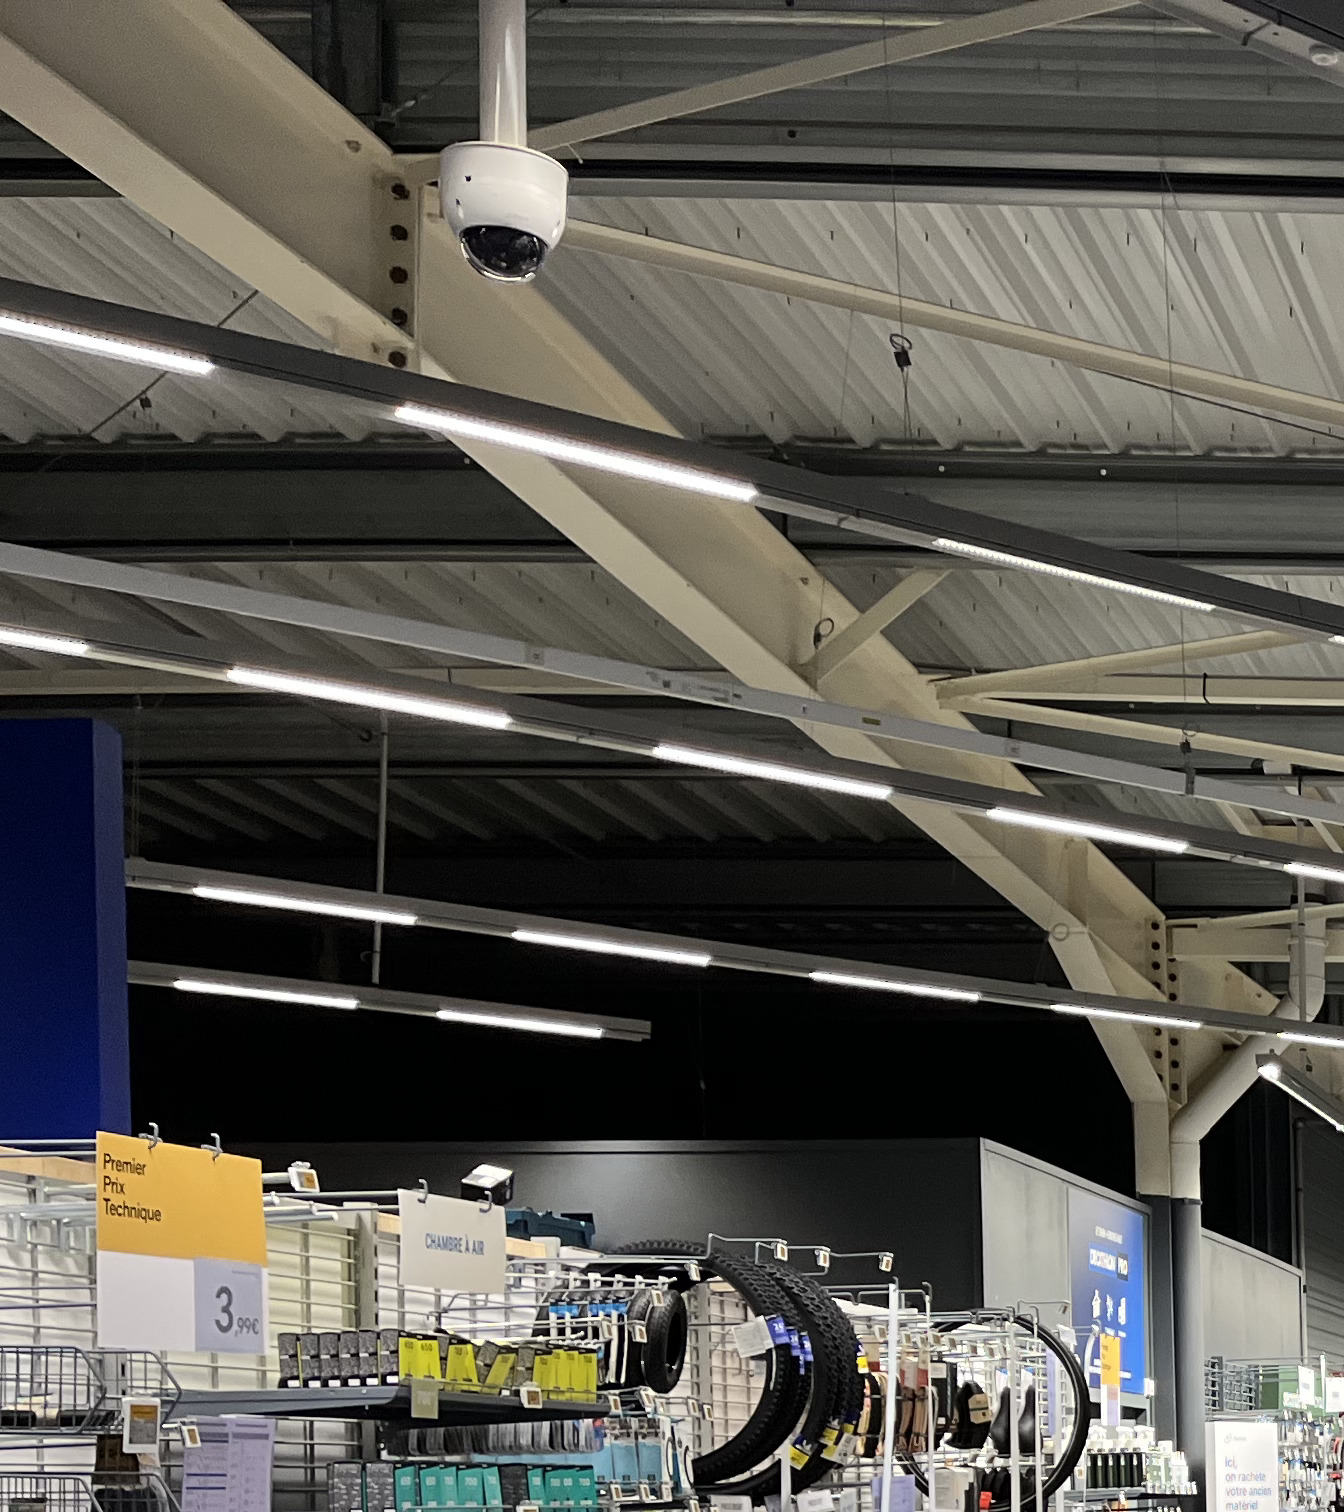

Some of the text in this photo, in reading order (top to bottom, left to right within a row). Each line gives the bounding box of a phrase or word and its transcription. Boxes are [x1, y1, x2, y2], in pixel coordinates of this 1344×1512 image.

[103, 1152, 147, 1176] Premier
[103, 1175, 126, 1196] Prix
[103, 1197, 162, 1223] Technique
[425, 1232, 485, 1256] CHAMBRE À AIR
[1225, 1473, 1237, 1482] on
[1225, 1486, 1272, 1497] votre ancien
